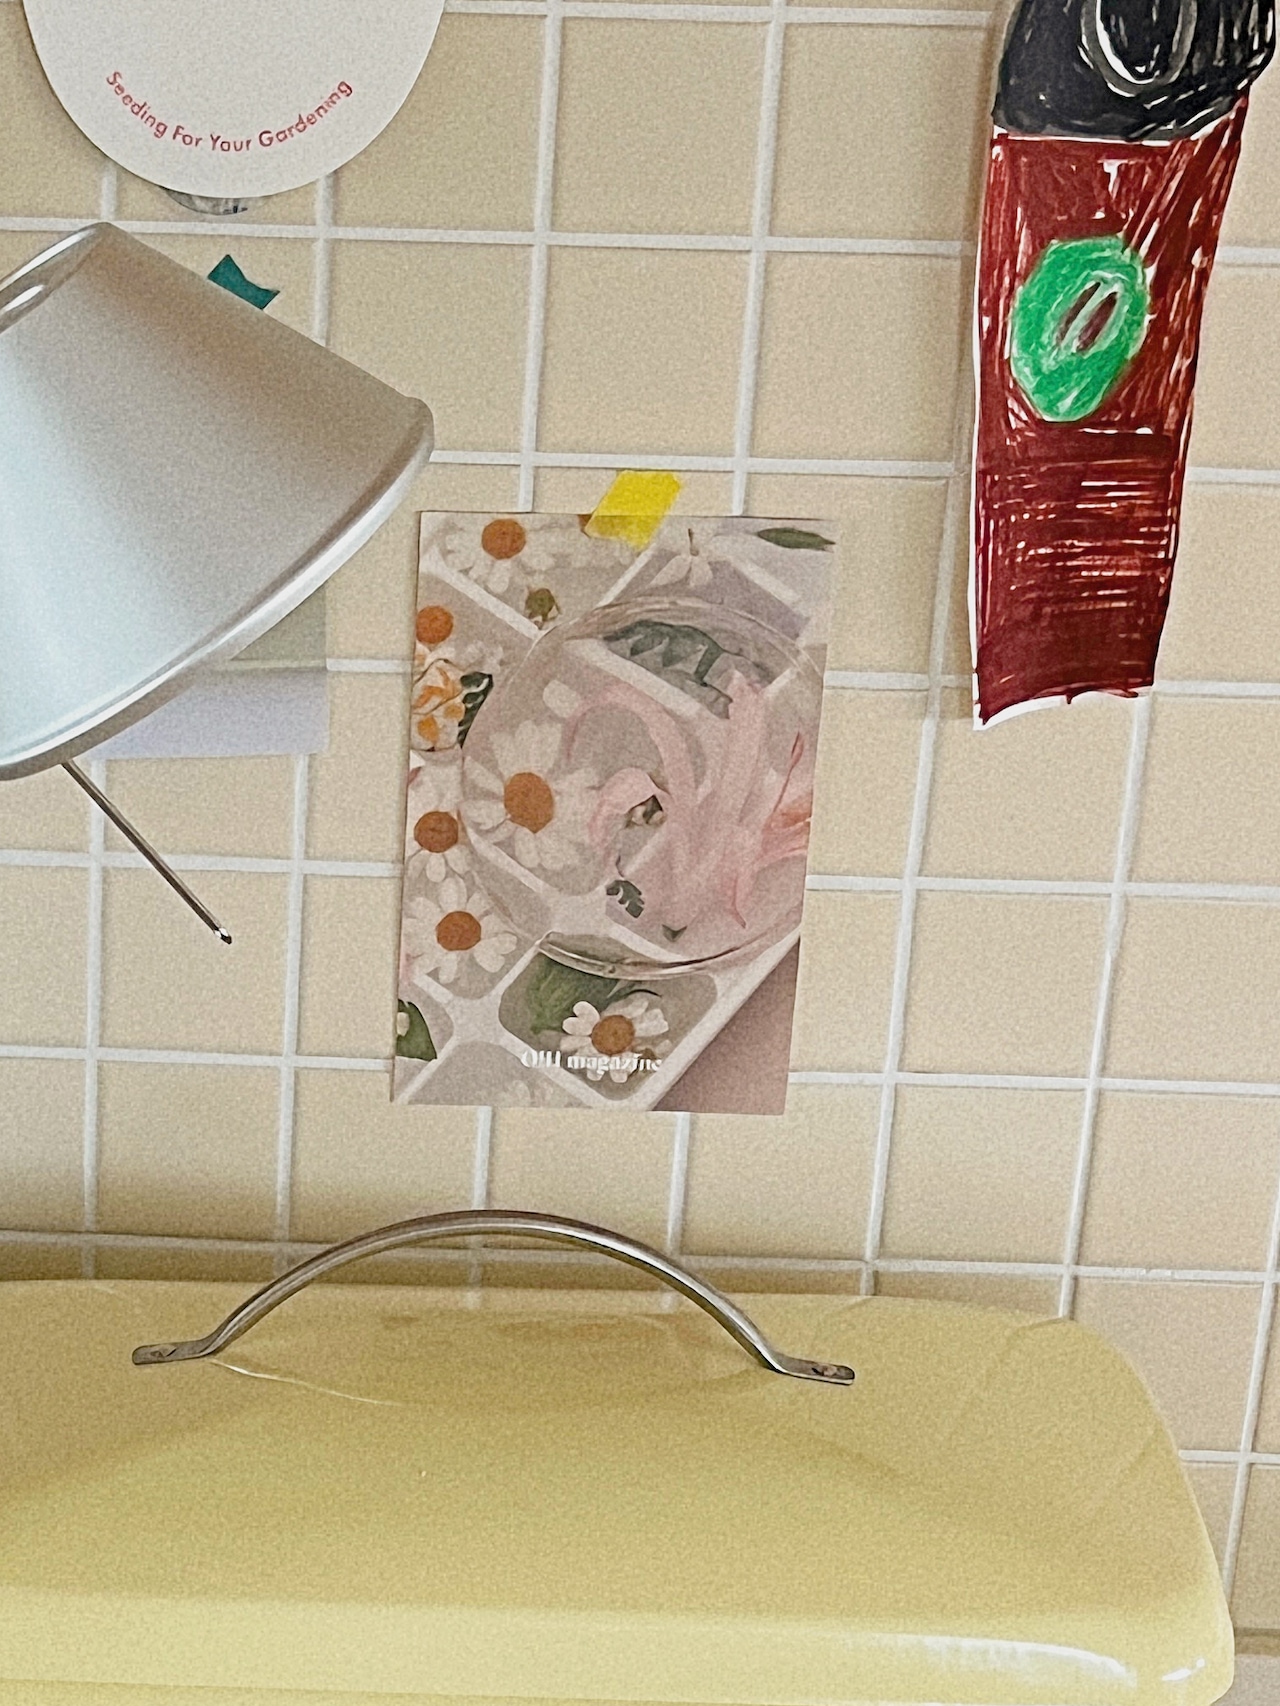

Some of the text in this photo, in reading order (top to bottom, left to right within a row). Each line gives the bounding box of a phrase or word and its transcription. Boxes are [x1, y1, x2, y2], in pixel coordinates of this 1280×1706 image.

[106, 71, 354, 153] Seeding For Your Gardening
